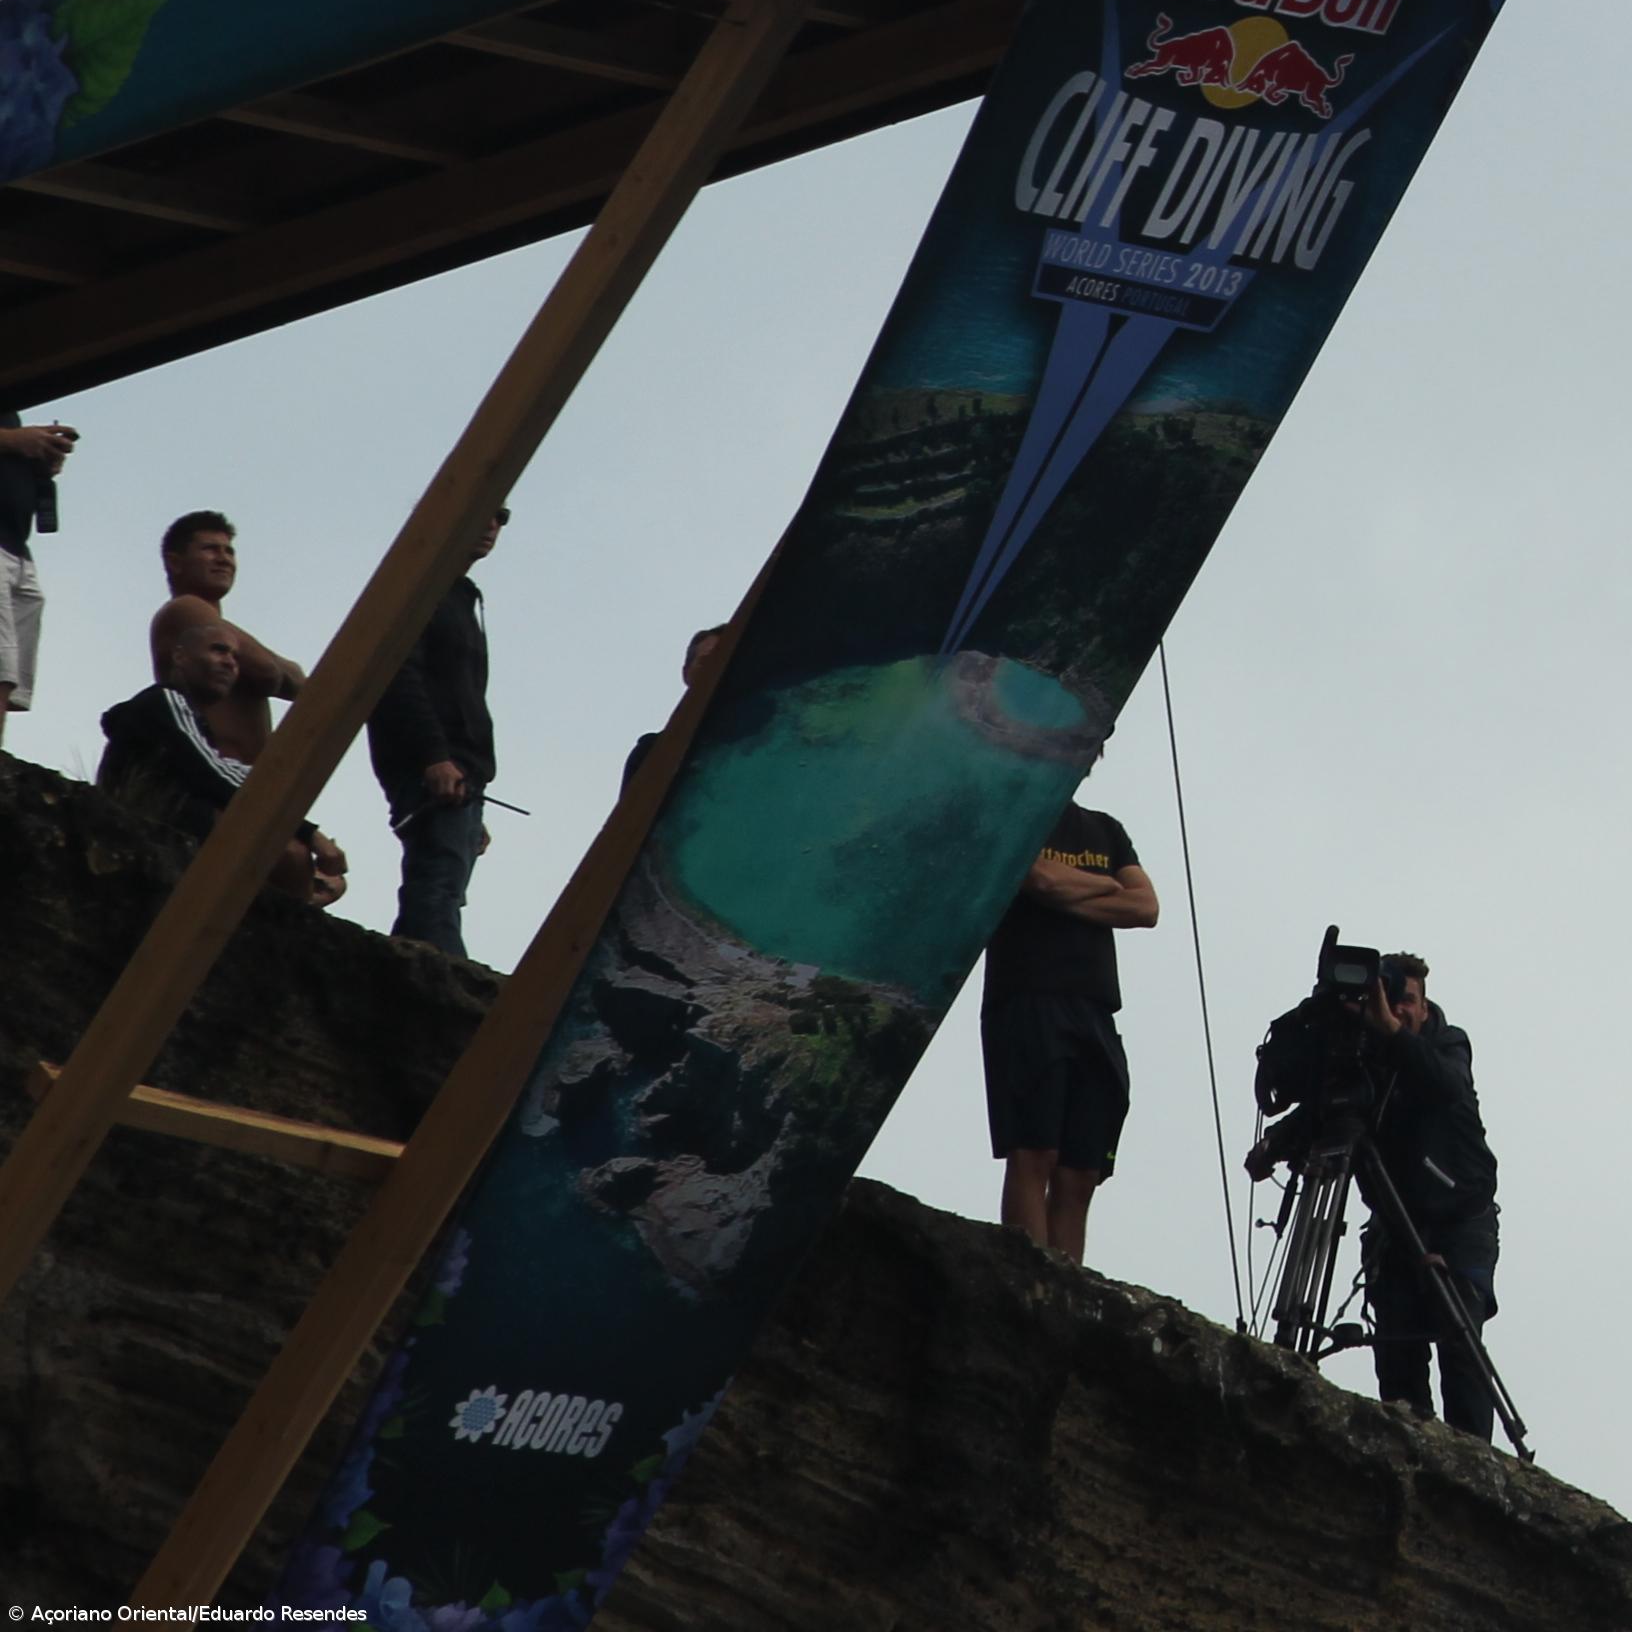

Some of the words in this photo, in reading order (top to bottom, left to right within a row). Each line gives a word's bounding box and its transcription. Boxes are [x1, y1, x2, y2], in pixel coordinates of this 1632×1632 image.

[1015, 70, 1176, 228] CLIFF
[1142, 117, 1372, 270] DIVING
[1044, 233, 1113, 269] WORLD
[1115, 248, 1183, 284] SERIES
[1183, 262, 1244, 297] 2013
[1121, 286, 1192, 317] PORTUGAL
